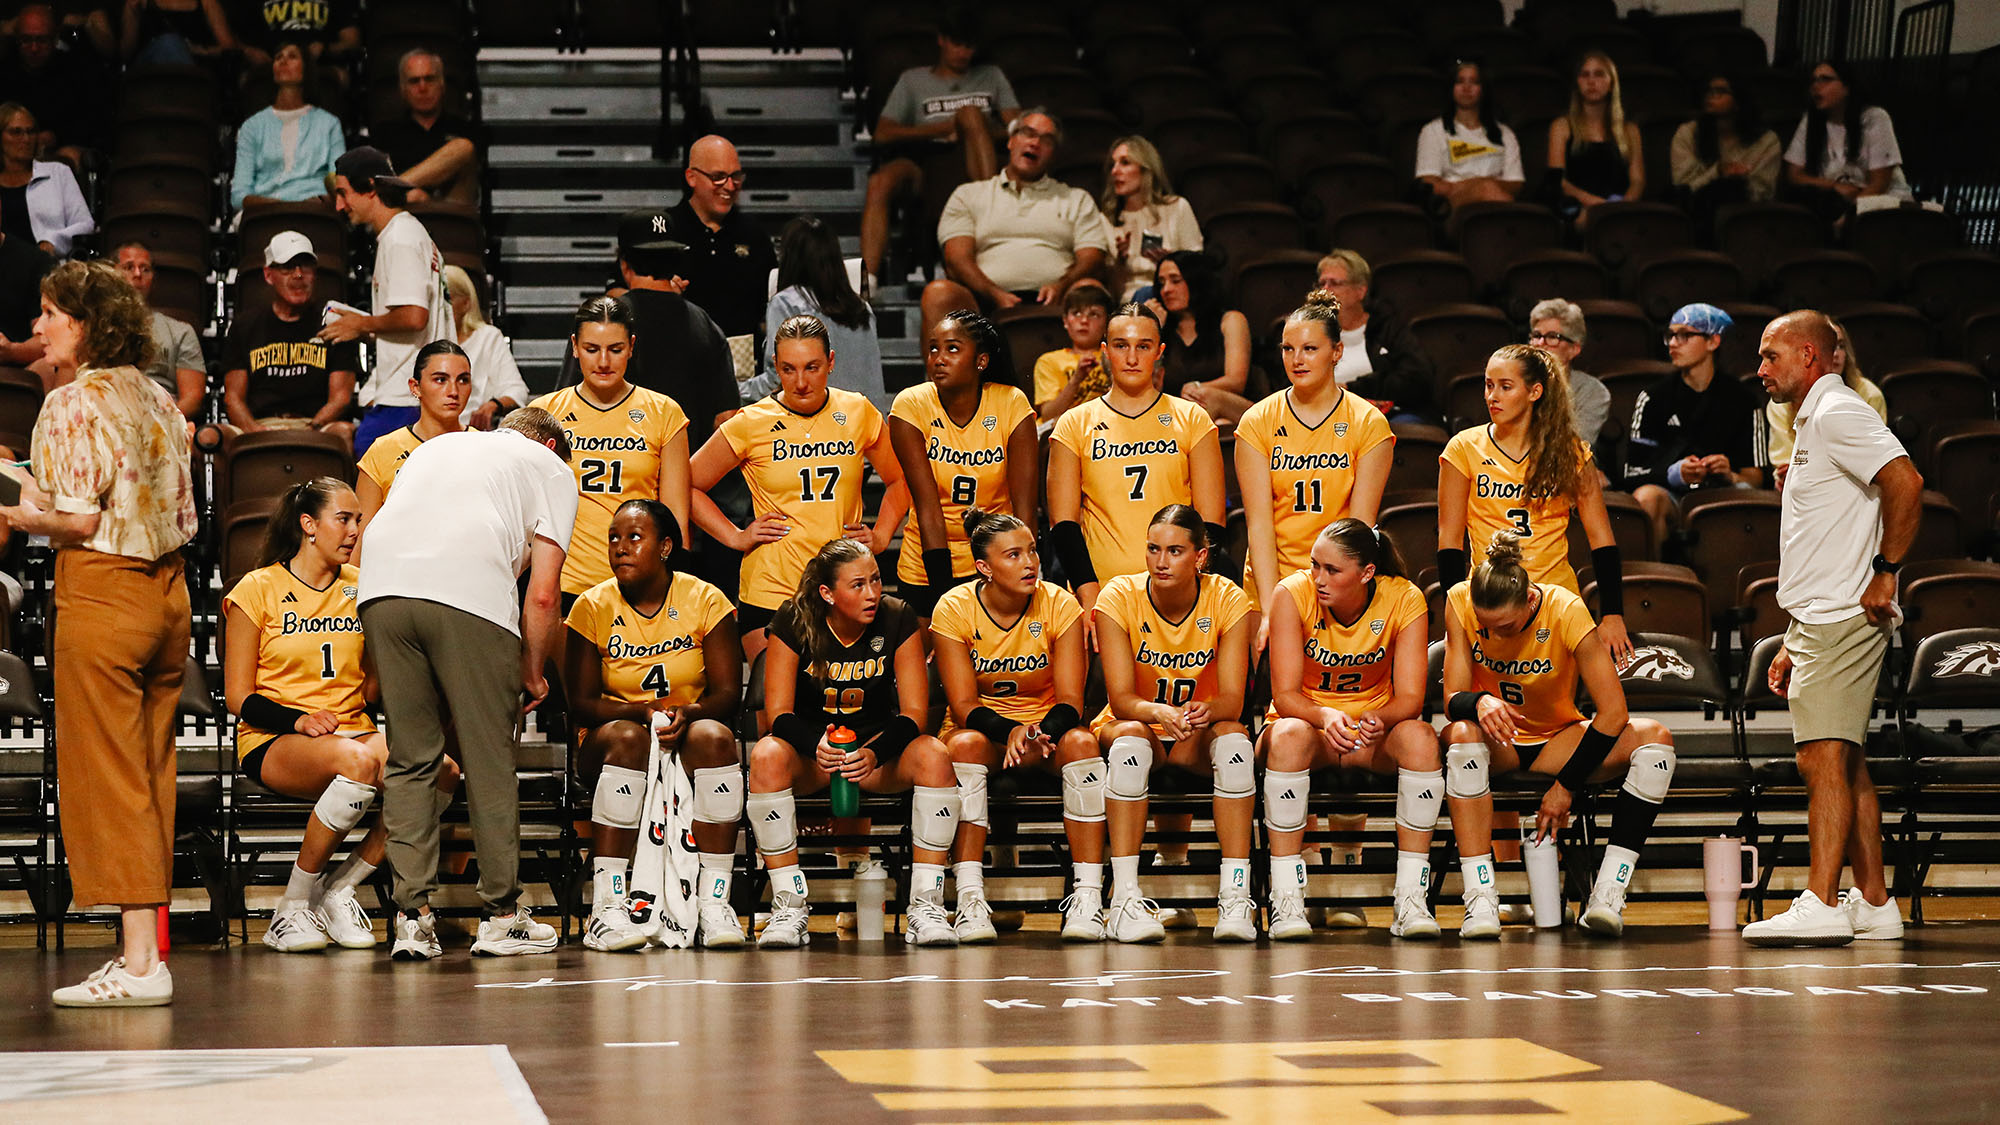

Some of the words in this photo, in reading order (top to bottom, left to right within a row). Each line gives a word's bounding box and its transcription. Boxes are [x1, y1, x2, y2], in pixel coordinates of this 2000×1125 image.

[263, 1, 329, 25] WMU
[249, 342, 289, 373] WESTERN
[289, 342, 327, 369] MICHIGAN
[267, 365, 308, 377] BRONCOS
[772, 438, 856, 462] Broncos
[928, 436, 1005, 467] Broncos
[1091, 438, 1179, 461] Broncos
[1270, 446, 1350, 471] Broncos
[580, 458, 623, 494] 21
[798, 465, 841, 502] 17
[951, 474, 977, 506] 8
[1124, 464, 1149, 500] 7
[1293, 479, 1323, 513] 11
[1506, 508, 1533, 538] 3
[281, 611, 363, 635] Broncos
[320, 642, 336, 679] 1
[607, 634, 695, 659] Broncos
[1303, 637, 1386, 667] Broncos
[640, 663, 670, 699] 4
[993, 680, 1018, 698] 2
[1154, 677, 1197, 707] 10
[1318, 671, 1362, 692] 12
[1499, 680, 1525, 706] 6
[822, 687, 865, 715] 19
[506, 927, 531, 941] HOKA
[983, 994, 1296, 1008] KATHY
[1341, 983, 1990, 1002] BEAUREGARD
